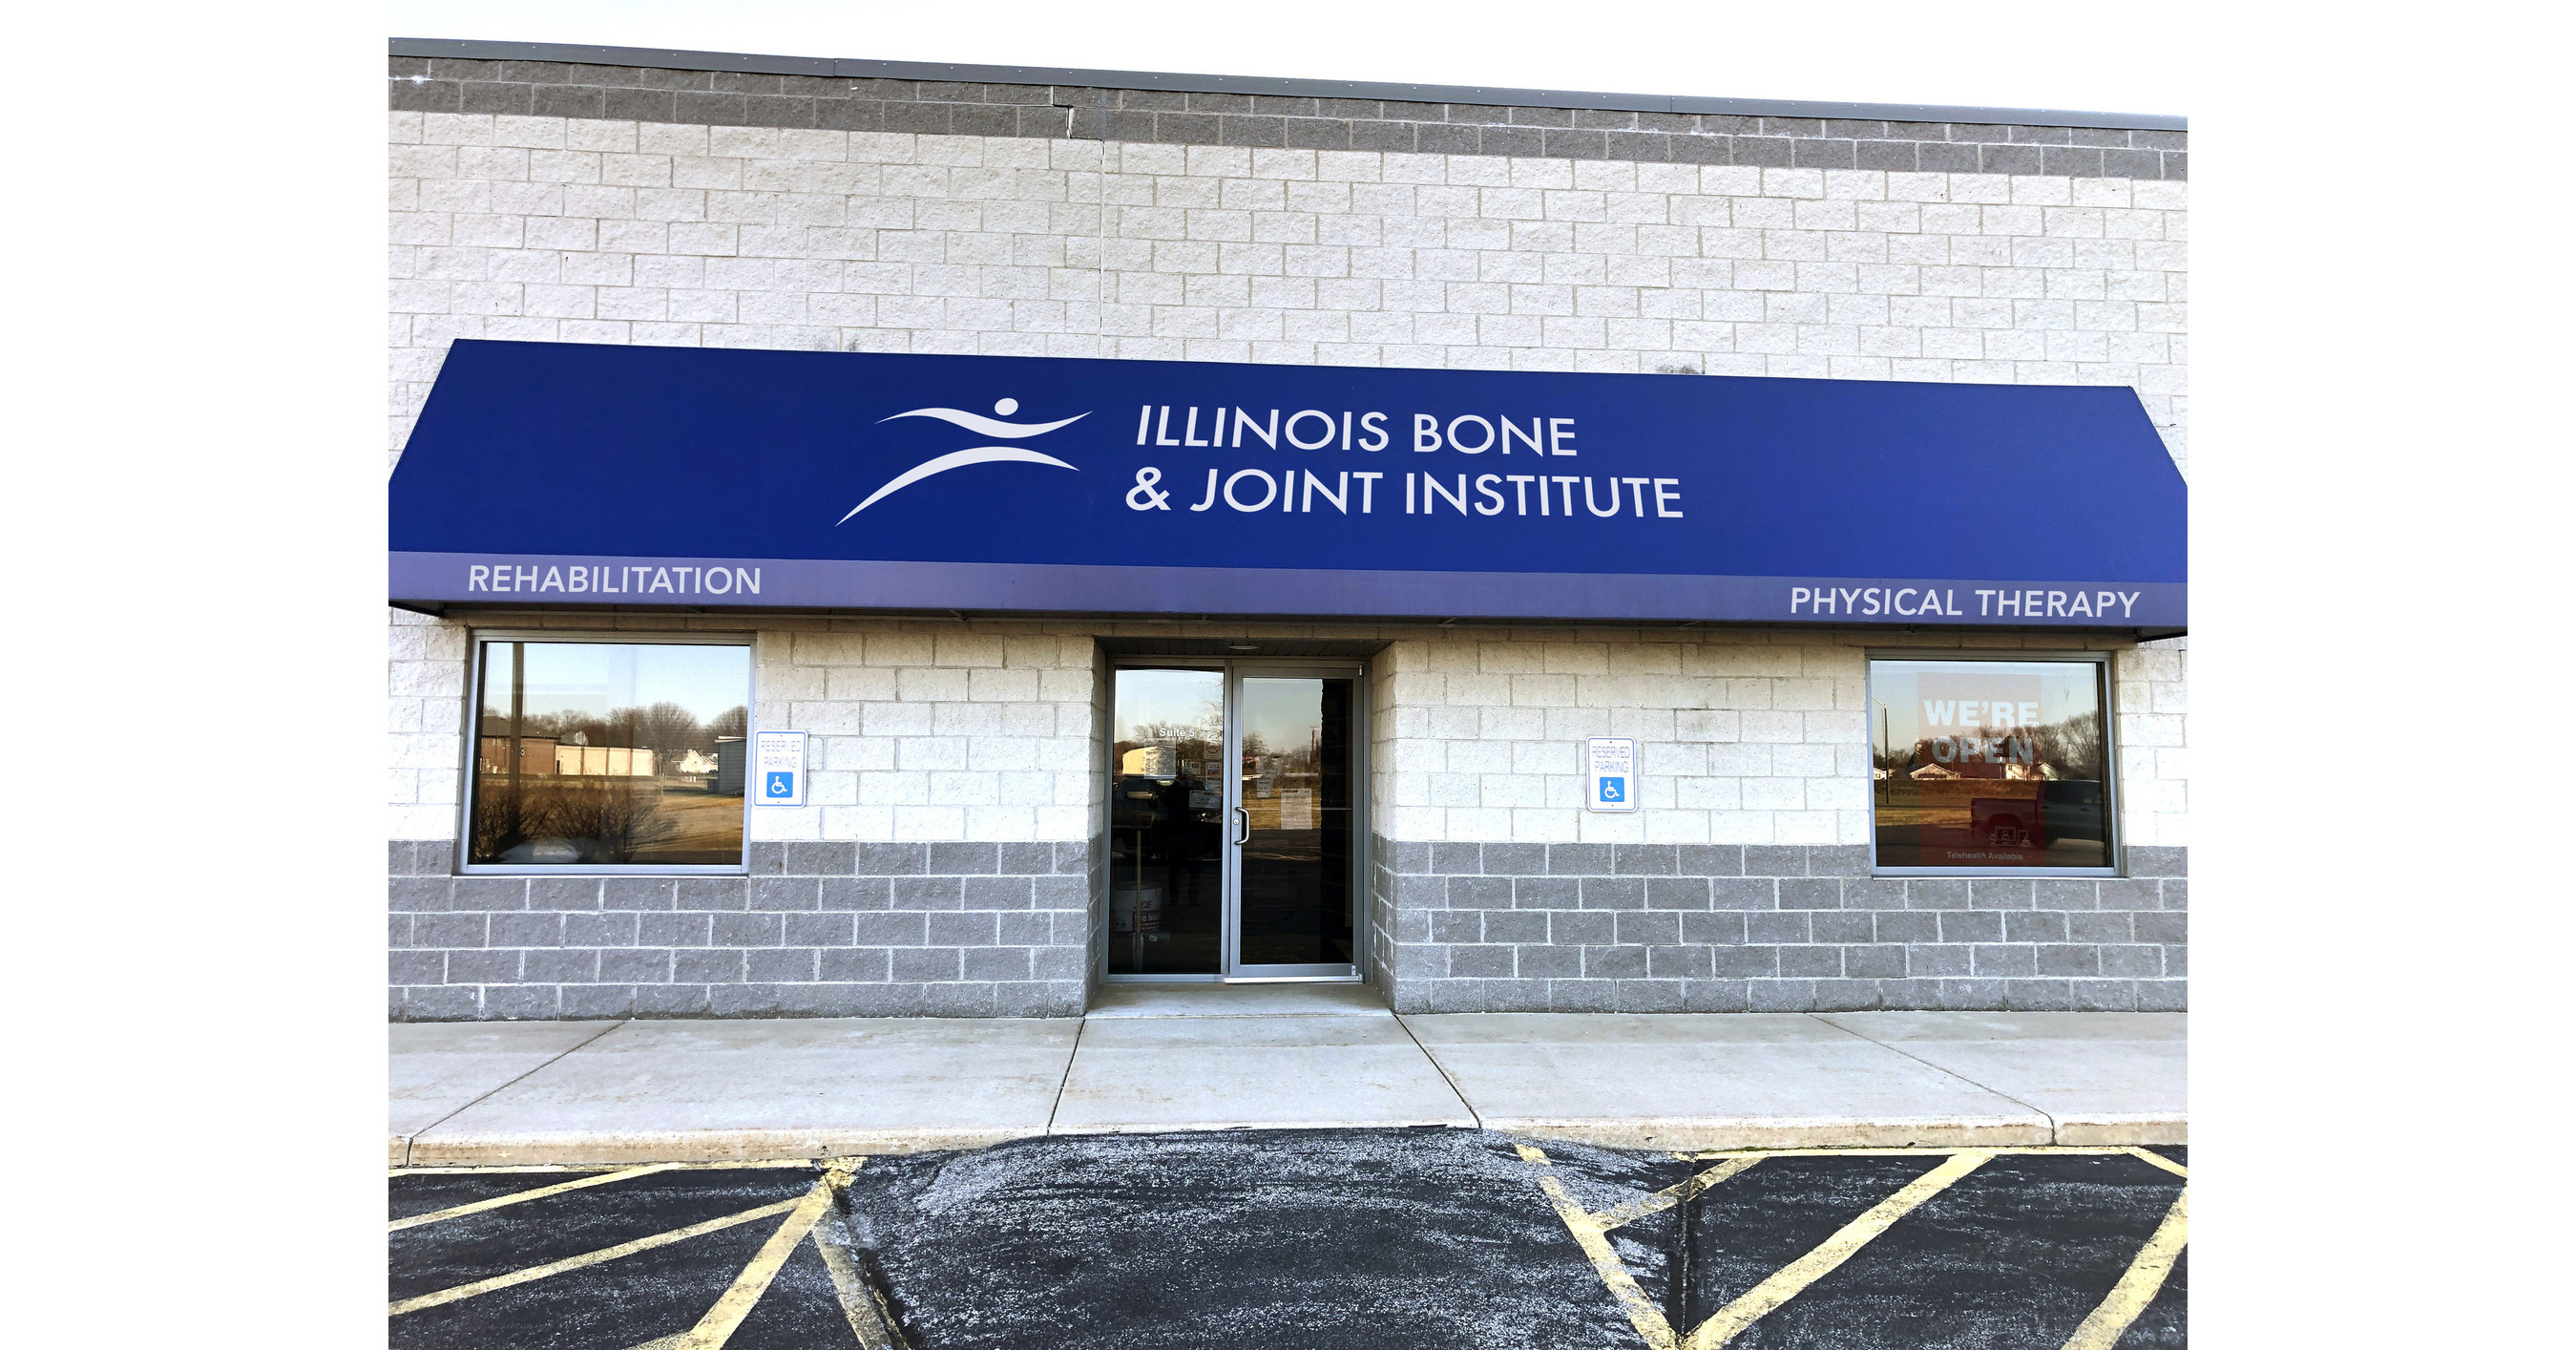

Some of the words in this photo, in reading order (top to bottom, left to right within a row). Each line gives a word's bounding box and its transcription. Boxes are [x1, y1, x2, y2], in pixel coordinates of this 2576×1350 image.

[1137, 405, 1390, 452] ILLINOIS
[1414, 413, 1578, 456] BONE
[1126, 466, 1171, 511] &
[1190, 468, 1384, 515] JOINT
[1406, 471, 1684, 517] INSTITUTE
[468, 564, 761, 595] REHABILITATION
[1791, 587, 1963, 616] PHYSICAL
[1975, 589, 2141, 619] THERAPY
[1923, 700, 2039, 728] WE'RE
[1160, 728, 1186, 737] Suite
[1189, 728, 1195, 737] 5
[761, 741, 801, 752] RESERVED
[1592, 746, 1630, 759] RESERVED
[1932, 736, 2033, 764] OPEN
[764, 756, 797, 769] PARKING
[1595, 760, 1628, 773] PARKING
[1947, 851, 1986, 859] Telehealth
[1988, 852, 2023, 860] Available
